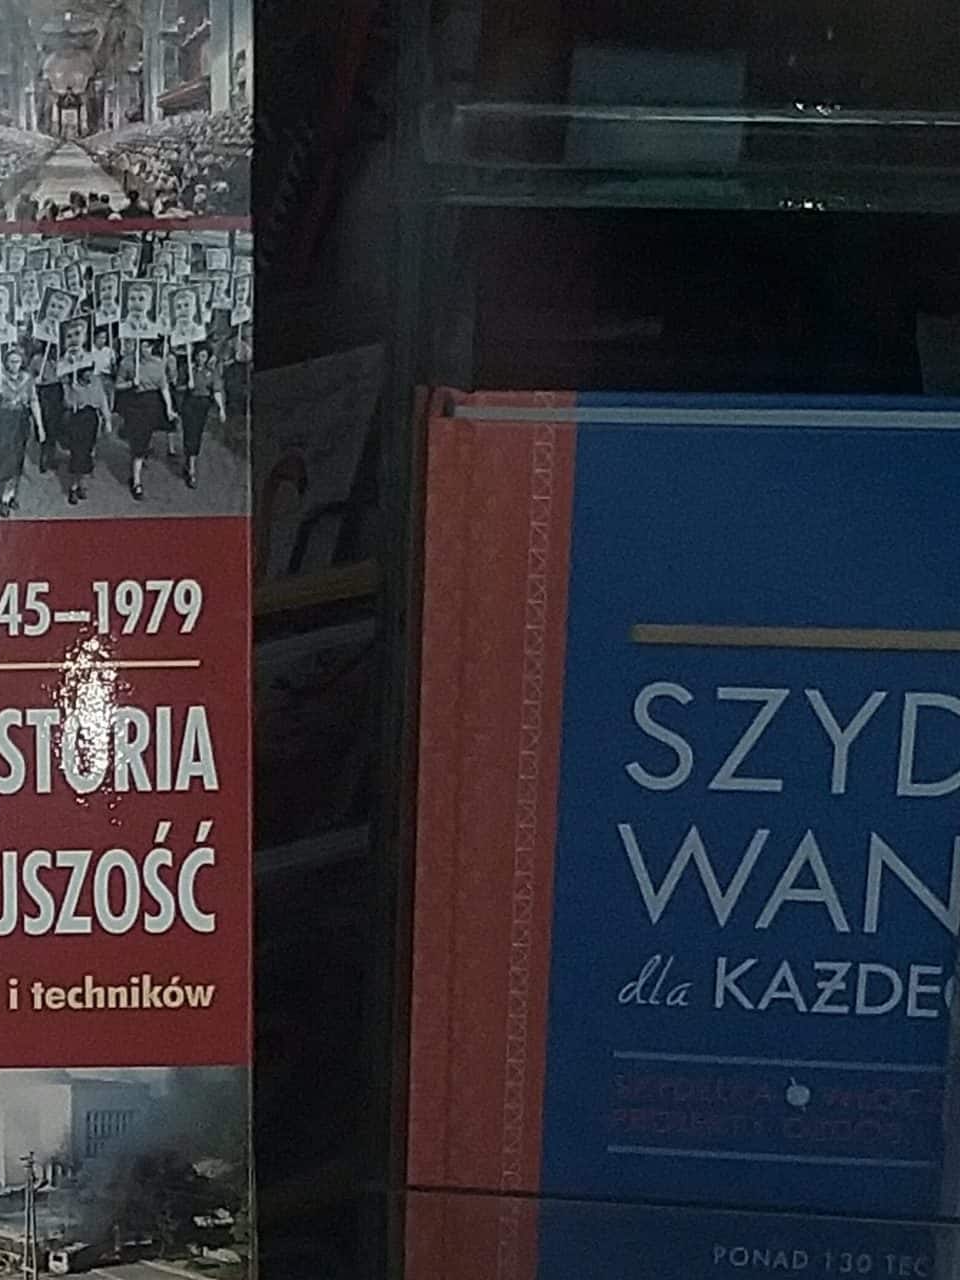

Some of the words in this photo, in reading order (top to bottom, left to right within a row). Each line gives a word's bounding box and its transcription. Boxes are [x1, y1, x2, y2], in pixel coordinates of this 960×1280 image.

[624, 681, 960, 798] SZYD
[616, 822, 960, 936] WAN
[7, 976, 20, 1011] i
[30, 973, 216, 1010] techników
[617, 952, 692, 1009] dla
[714, 956, 954, 1019] KAŻDE
[712, 1245, 810, 1272] PONAD
[823, 1249, 873, 1275] 130
